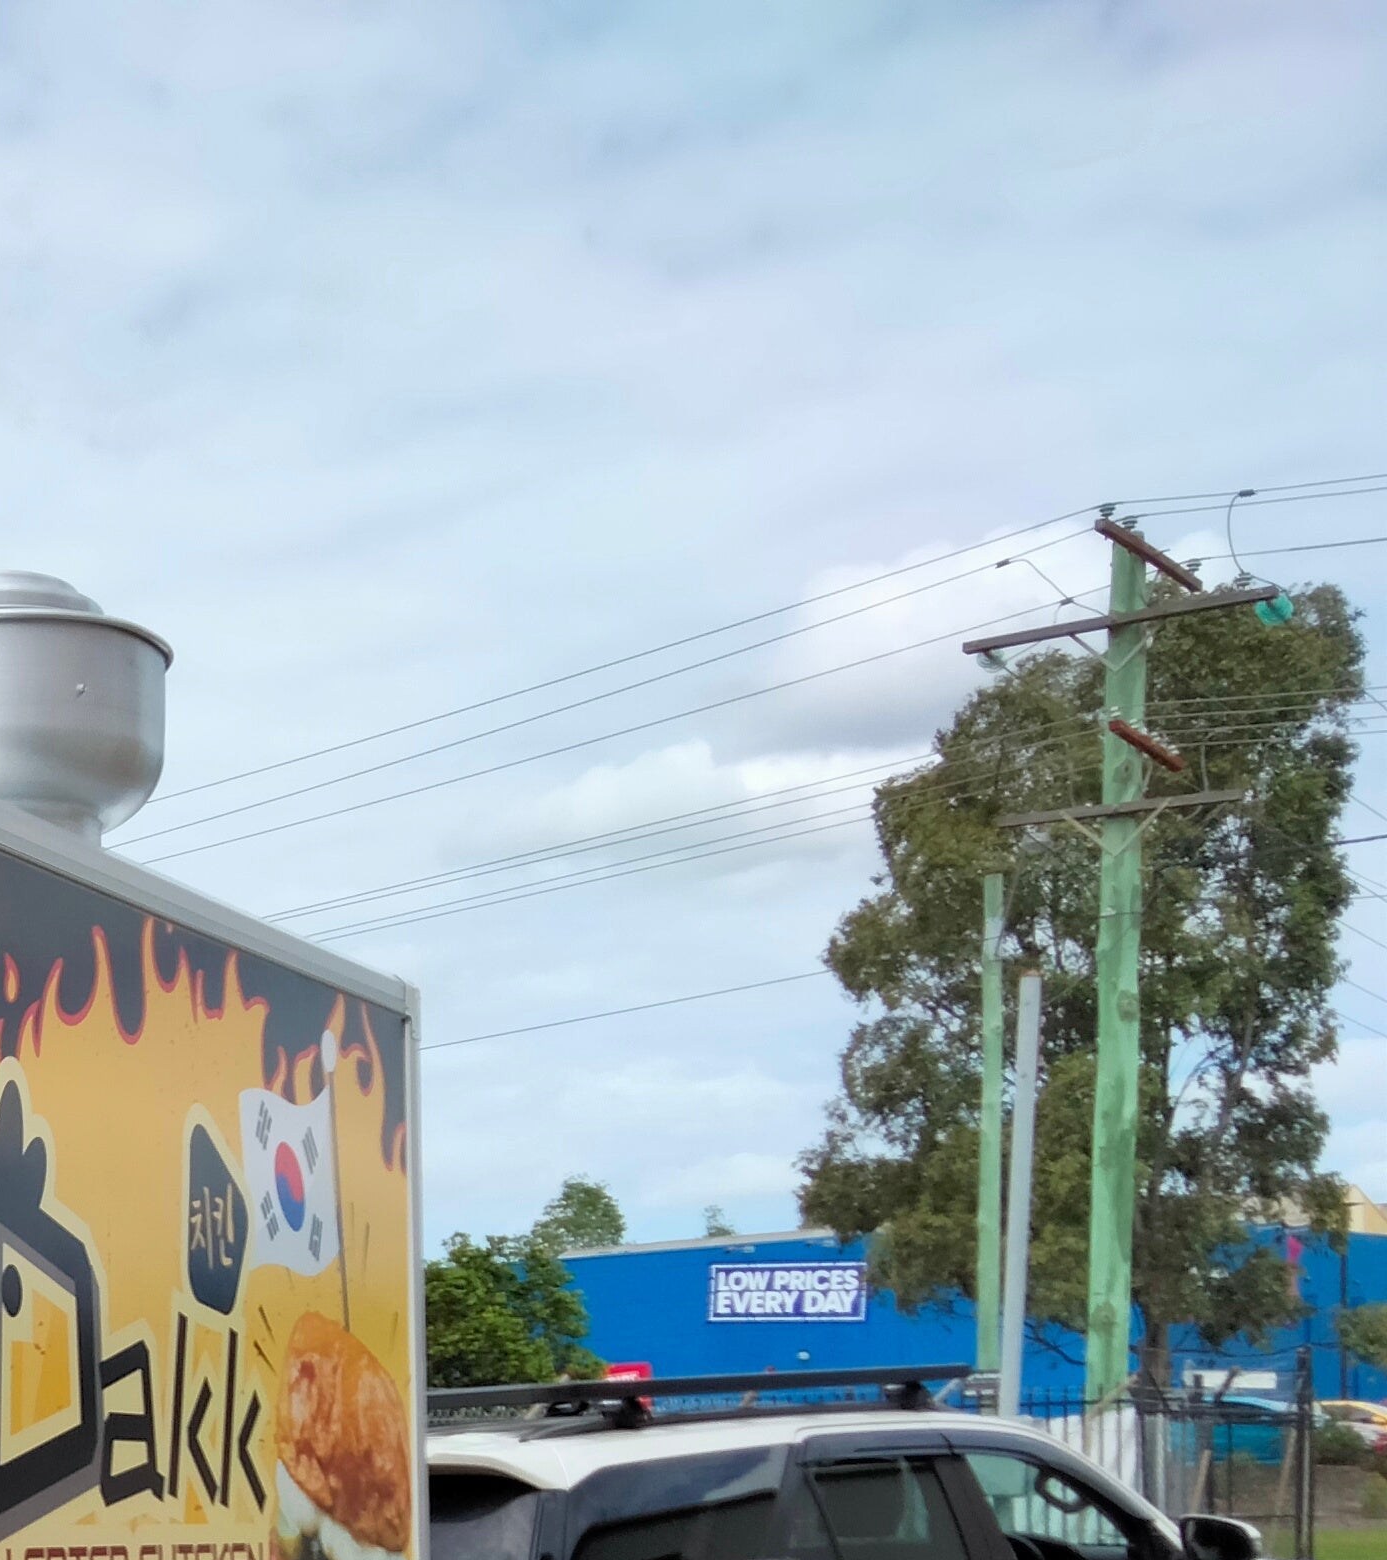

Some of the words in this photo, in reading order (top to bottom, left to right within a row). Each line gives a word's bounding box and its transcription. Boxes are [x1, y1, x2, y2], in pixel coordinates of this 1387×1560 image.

[189, 1182, 235, 1270] 치킨
[716, 1270, 770, 1291] LOW
[773, 1269, 860, 1291] PRICES
[716, 1291, 799, 1314] EVERY
[803, 1290, 858, 1314] DAY
